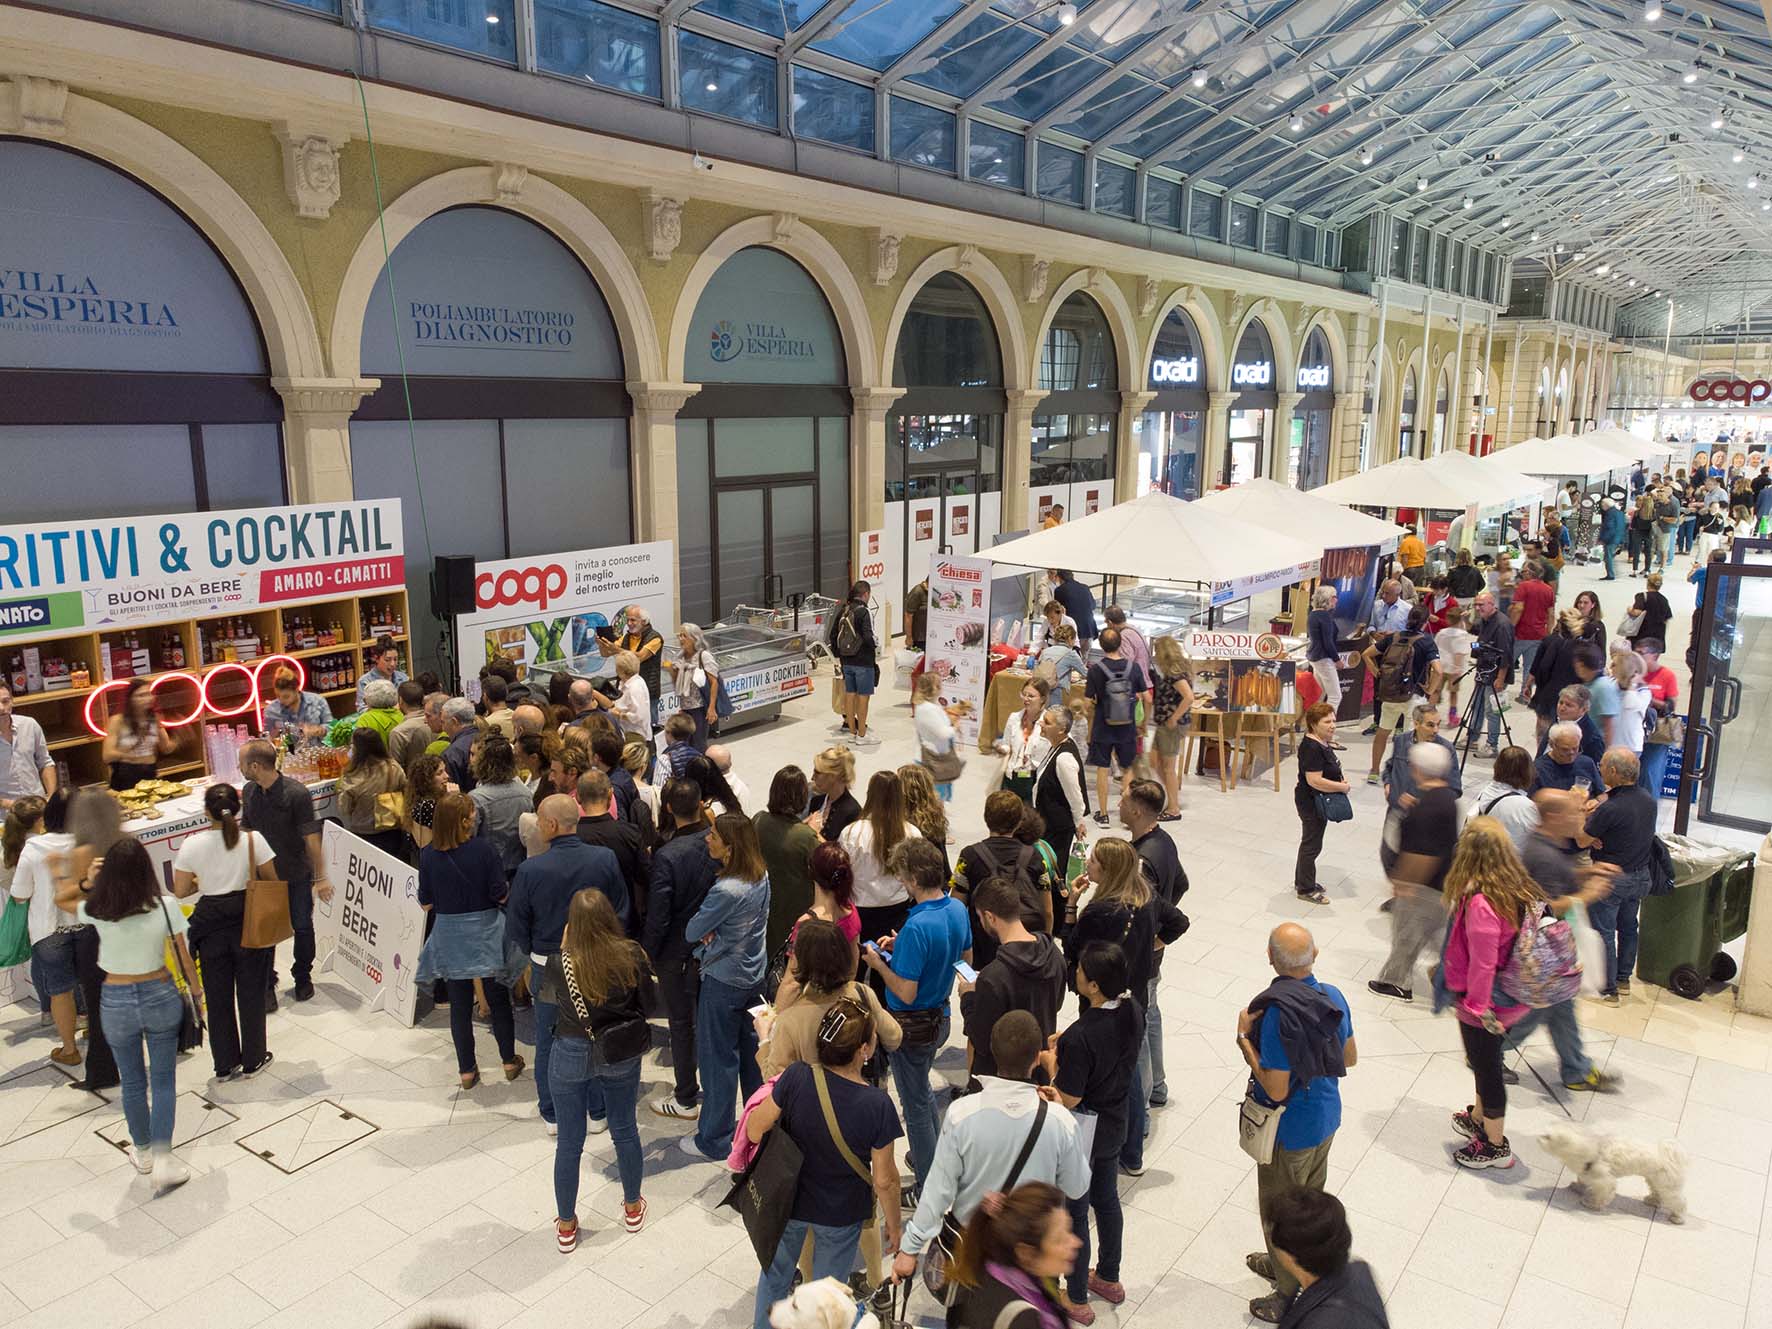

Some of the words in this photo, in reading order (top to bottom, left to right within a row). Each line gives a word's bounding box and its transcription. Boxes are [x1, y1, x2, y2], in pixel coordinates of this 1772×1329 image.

[0, 293, 178, 327] ESPERIA
[410, 302, 575, 327] POLIAMBULATORIO
[415, 320, 572, 346] DIAGNOSTICO
[747, 323, 786, 338] VILLA
[746, 338, 815, 357] ESPERIA
[1690, 380, 1771, 406] coop
[159, 523, 191, 574] &
[207, 507, 392, 569] COCKTAIL
[575, 559, 600, 571] invita
[608, 553, 651, 566] conoscere
[862, 562, 884, 579] coop
[942, 564, 980, 580] chiesa
[274, 570, 323, 593] AMARO
[335, 562, 391, 585] CAMATTI
[475, 563, 568, 610] coop
[575, 573, 581, 583] il
[583, 569, 614, 583] meglio
[575, 585, 590, 596] del
[592, 581, 620, 593] nostro
[622, 574, 660, 590] territorio
[107, 588, 165, 606] BUONI
[171, 585, 195, 598] DA
[199, 579, 242, 595] BERE
[120, 606, 146, 615] APERITIVI
[224, 593, 242, 602] coop
[1192, 634, 1252, 648] PARODI
[725, 673, 763, 692] APERITIVI
[764, 671, 770, 685] &
[773, 663, 807, 682] COCKTAIL
[1663, 787, 1677, 795] TIM
[168, 820, 198, 833] DELLA
[348, 852, 393, 899] BUONI
[345, 879, 364, 911] DA
[341, 904, 379, 947] BERE
[366, 964, 382, 984] coop
